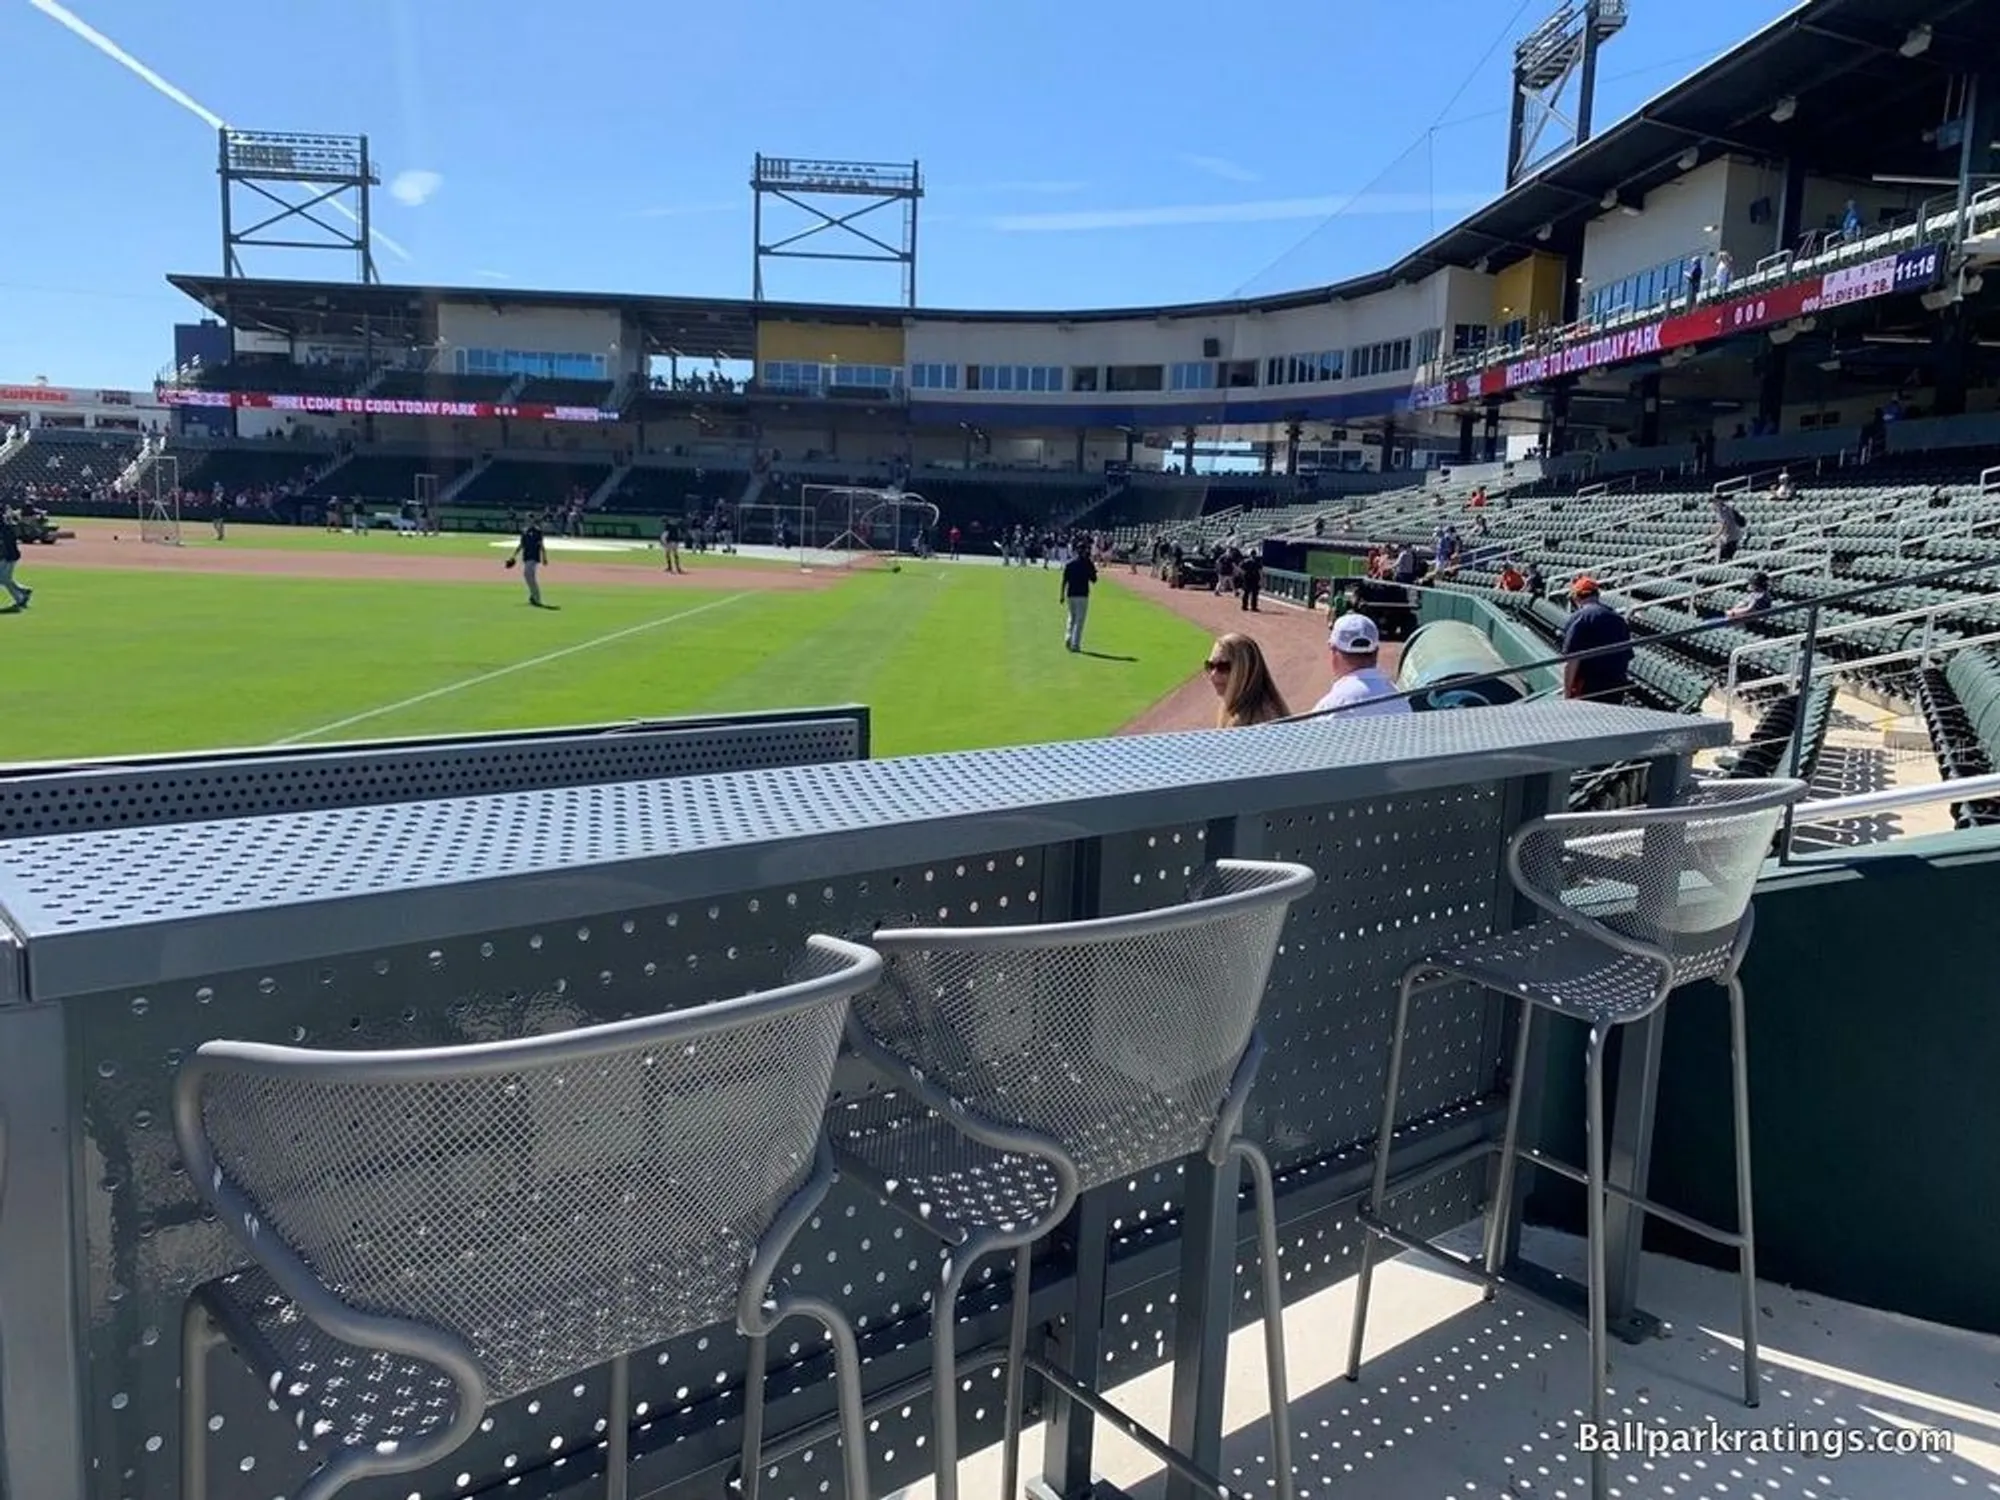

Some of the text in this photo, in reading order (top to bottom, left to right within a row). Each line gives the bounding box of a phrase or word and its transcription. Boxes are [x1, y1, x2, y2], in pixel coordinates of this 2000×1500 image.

[1896, 254, 1936, 281] 11:18
[1506, 356, 1549, 387] WELCOME
[1549, 354, 1561, 375] TO
[1563, 335, 1627, 371] COOLTODAY
[1627, 323, 1662, 358] PARK
[346, 398, 362, 412] TO
[364, 399, 439, 414] COOLTODAY
[441, 402, 478, 416] PARK
